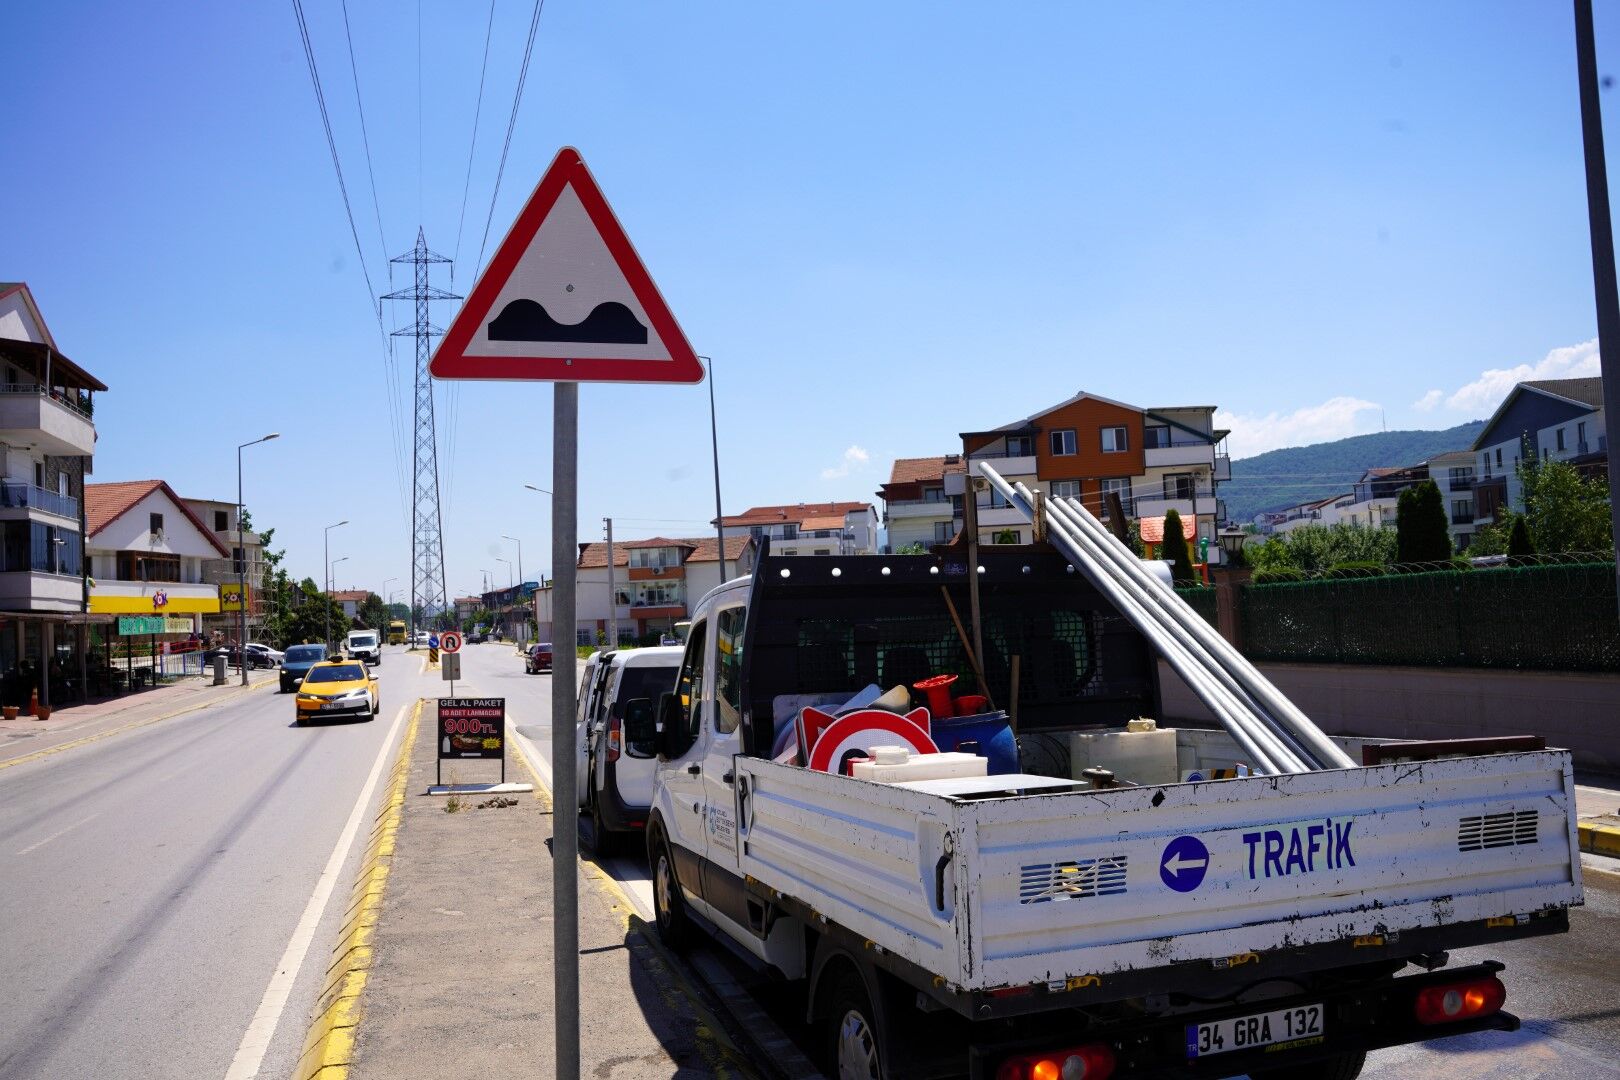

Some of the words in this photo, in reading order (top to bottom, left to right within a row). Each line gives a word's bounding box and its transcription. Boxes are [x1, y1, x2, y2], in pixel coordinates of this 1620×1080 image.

[1243, 818, 1356, 880] TRAFİK
[1188, 1044, 1198, 1052] TR
[1199, 1024, 1224, 1053] 34
[1234, 1015, 1272, 1047] GRA
[1284, 1007, 1319, 1037] 132
